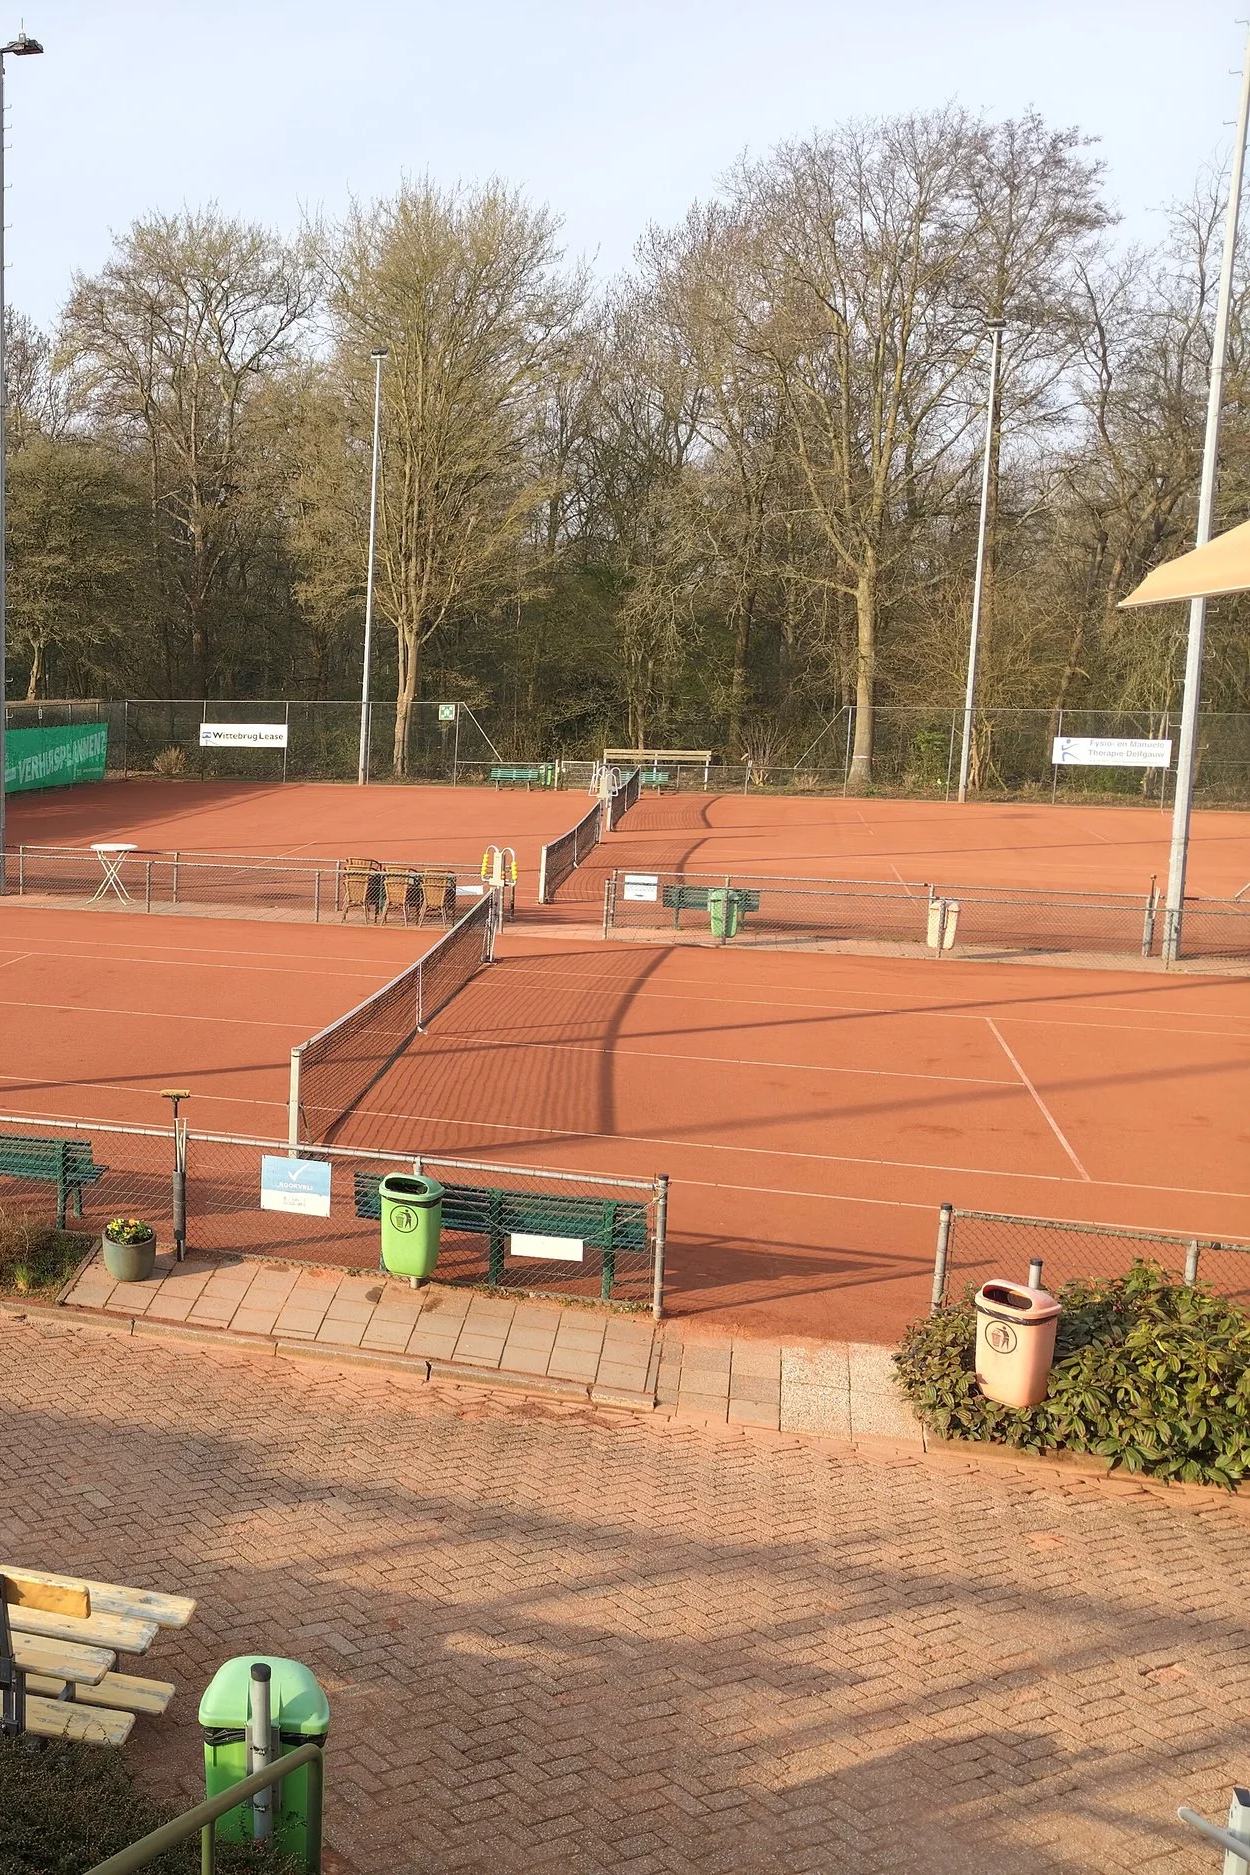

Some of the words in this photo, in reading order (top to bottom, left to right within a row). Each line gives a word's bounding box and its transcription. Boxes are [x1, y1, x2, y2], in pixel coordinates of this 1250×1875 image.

[213, 732, 258, 741] Wittebrug
[259, 732, 284, 741] Lease
[1088, 749, 1124, 758] Therapie
[1126, 750, 1165, 758] Delfgauw
